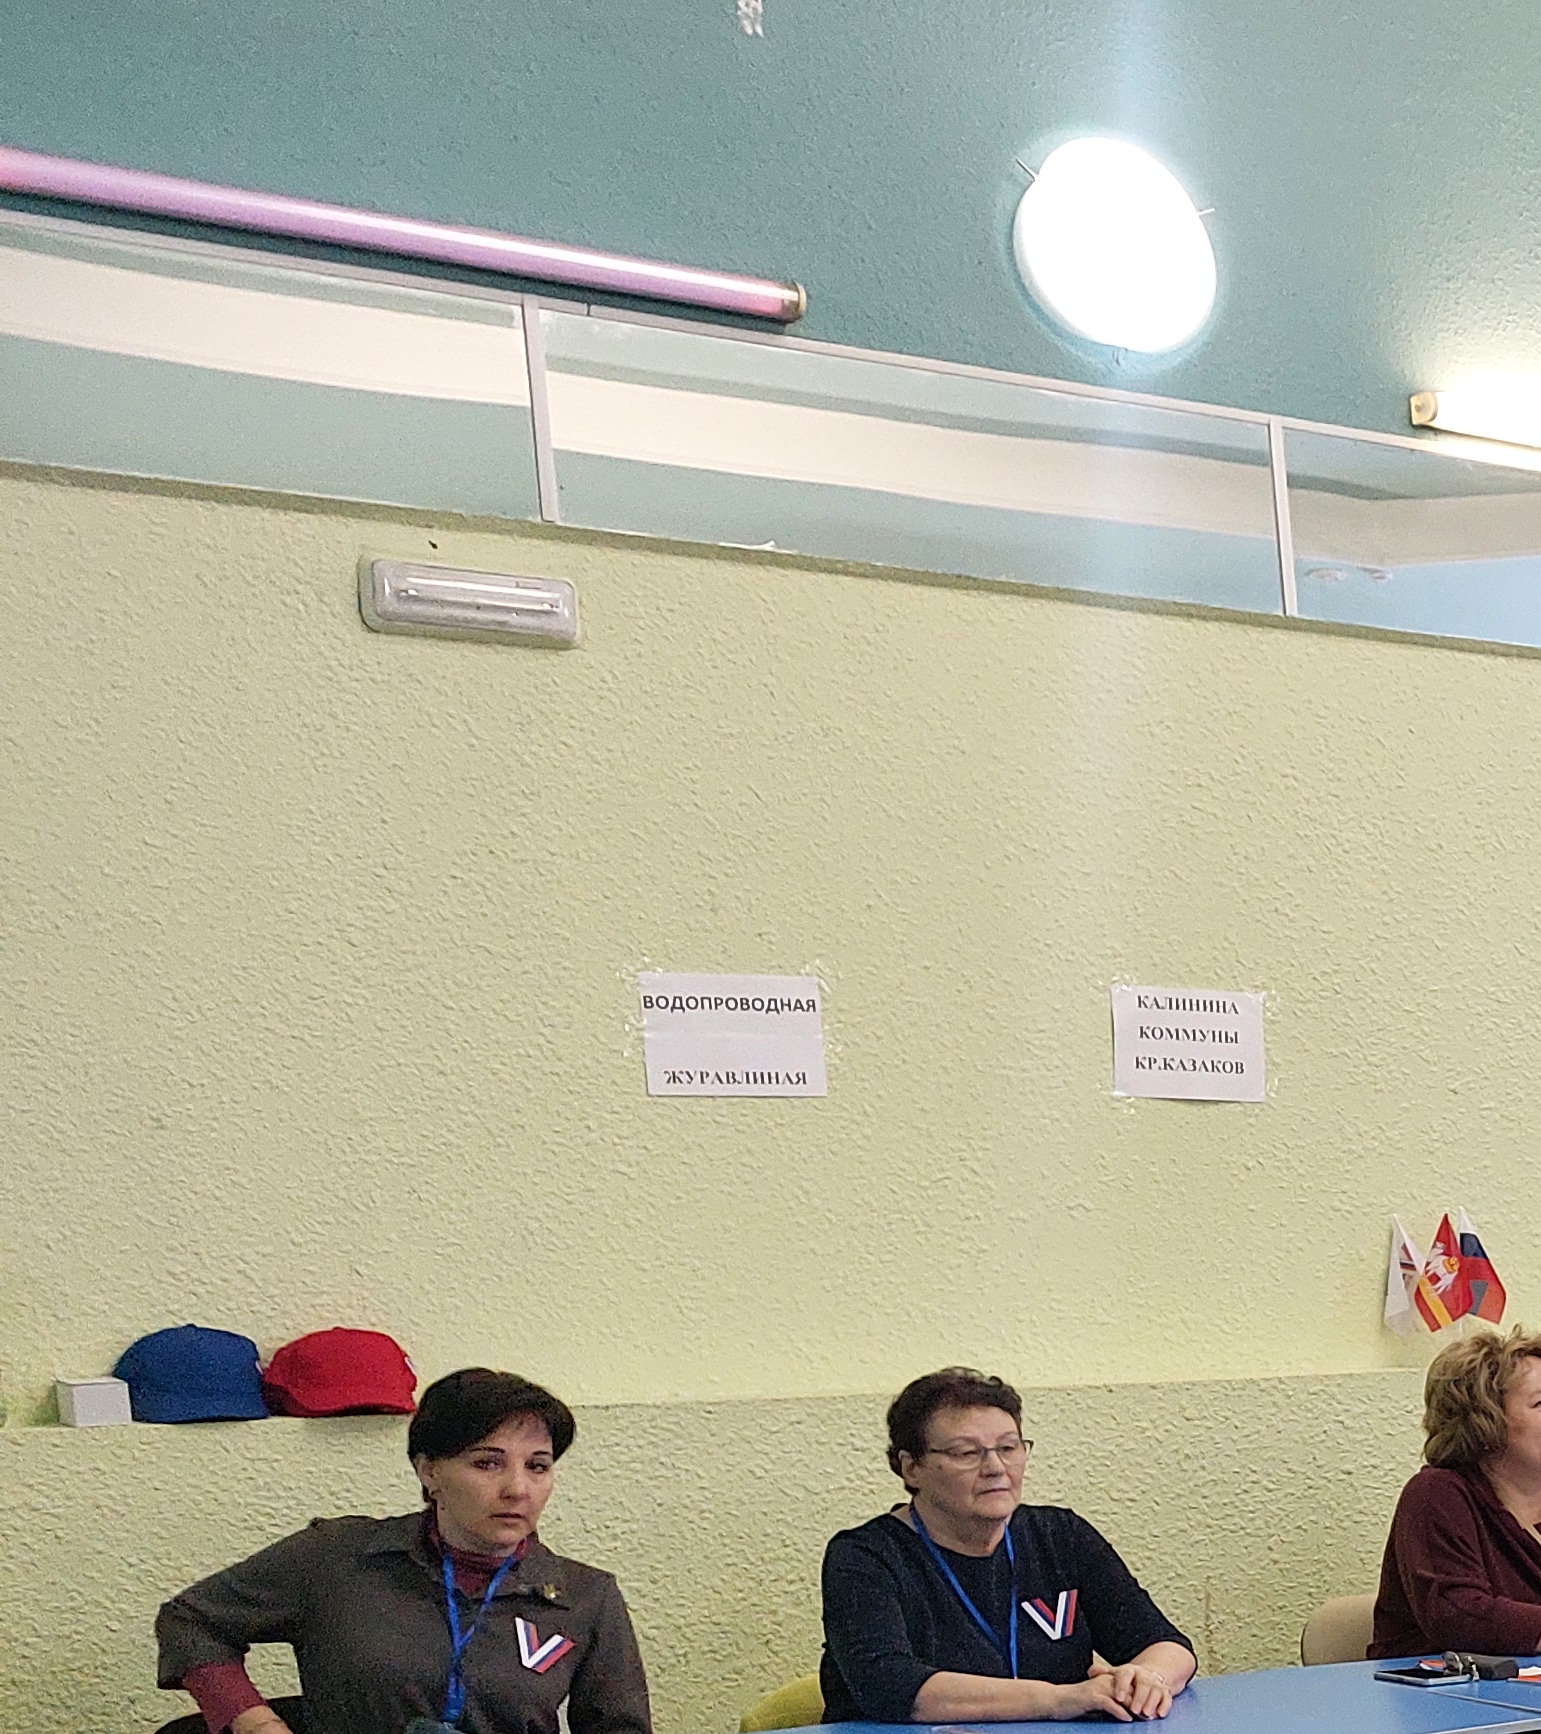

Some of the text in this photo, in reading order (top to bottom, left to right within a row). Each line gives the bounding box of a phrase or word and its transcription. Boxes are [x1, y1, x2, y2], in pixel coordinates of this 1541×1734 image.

[642, 995, 817, 1014] ВОДОПРОВОДНАЯ
[1136, 994, 1240, 1015] КАЛИНИНА
[1138, 1025, 1240, 1045] КОММУНЫ
[1134, 1055, 1246, 1075] КР.КАЗАКОВ
[663, 1070, 808, 1086] ЖУРАВЛИНАЯ
